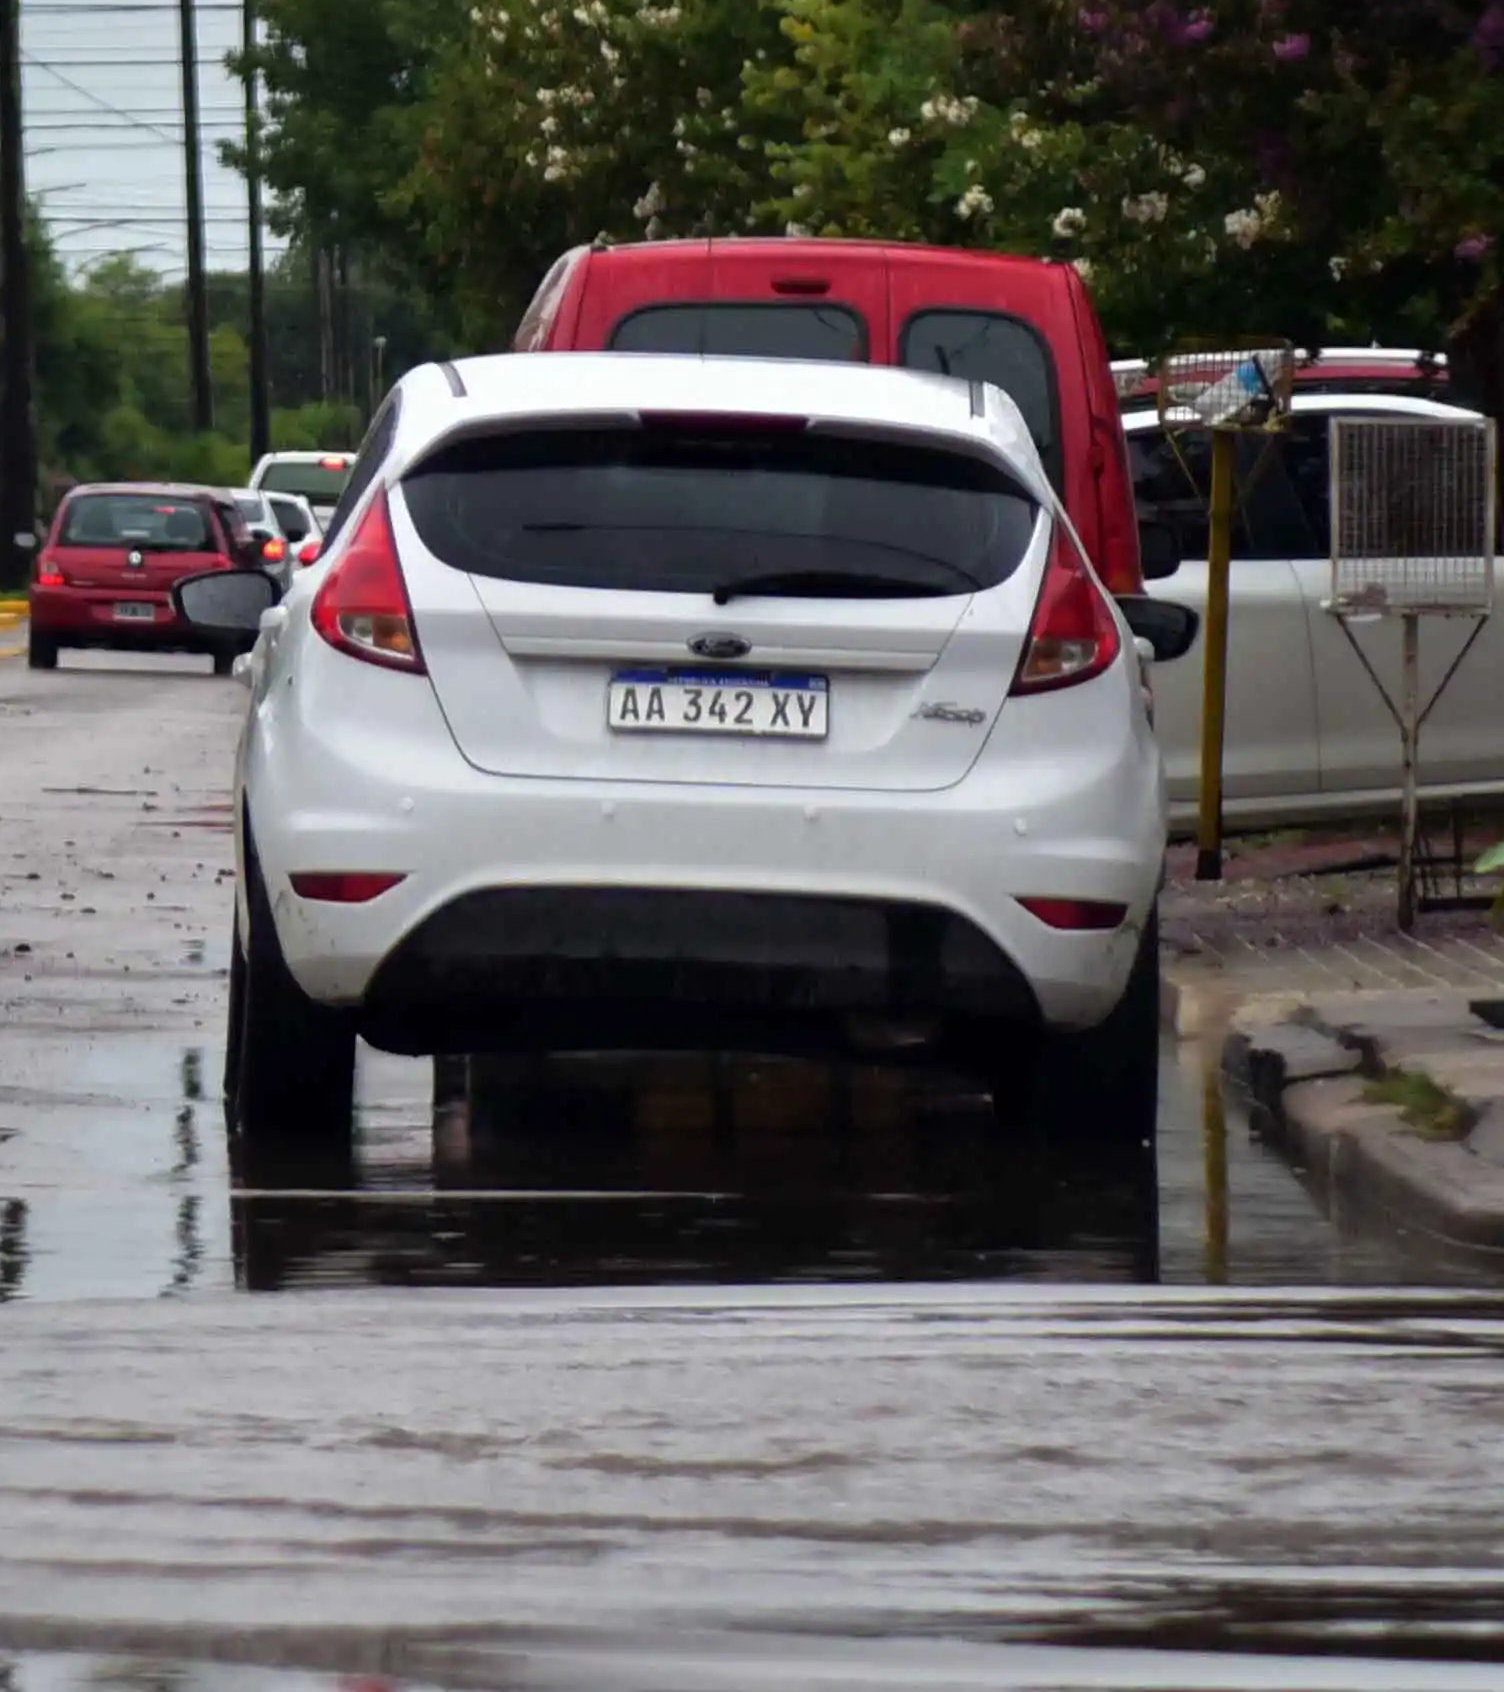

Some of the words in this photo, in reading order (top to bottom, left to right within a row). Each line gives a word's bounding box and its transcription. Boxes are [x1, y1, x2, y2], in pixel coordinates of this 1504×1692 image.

[619, 686, 666, 722] AA
[682, 688, 755, 725] 342
[770, 691, 816, 728] XY
